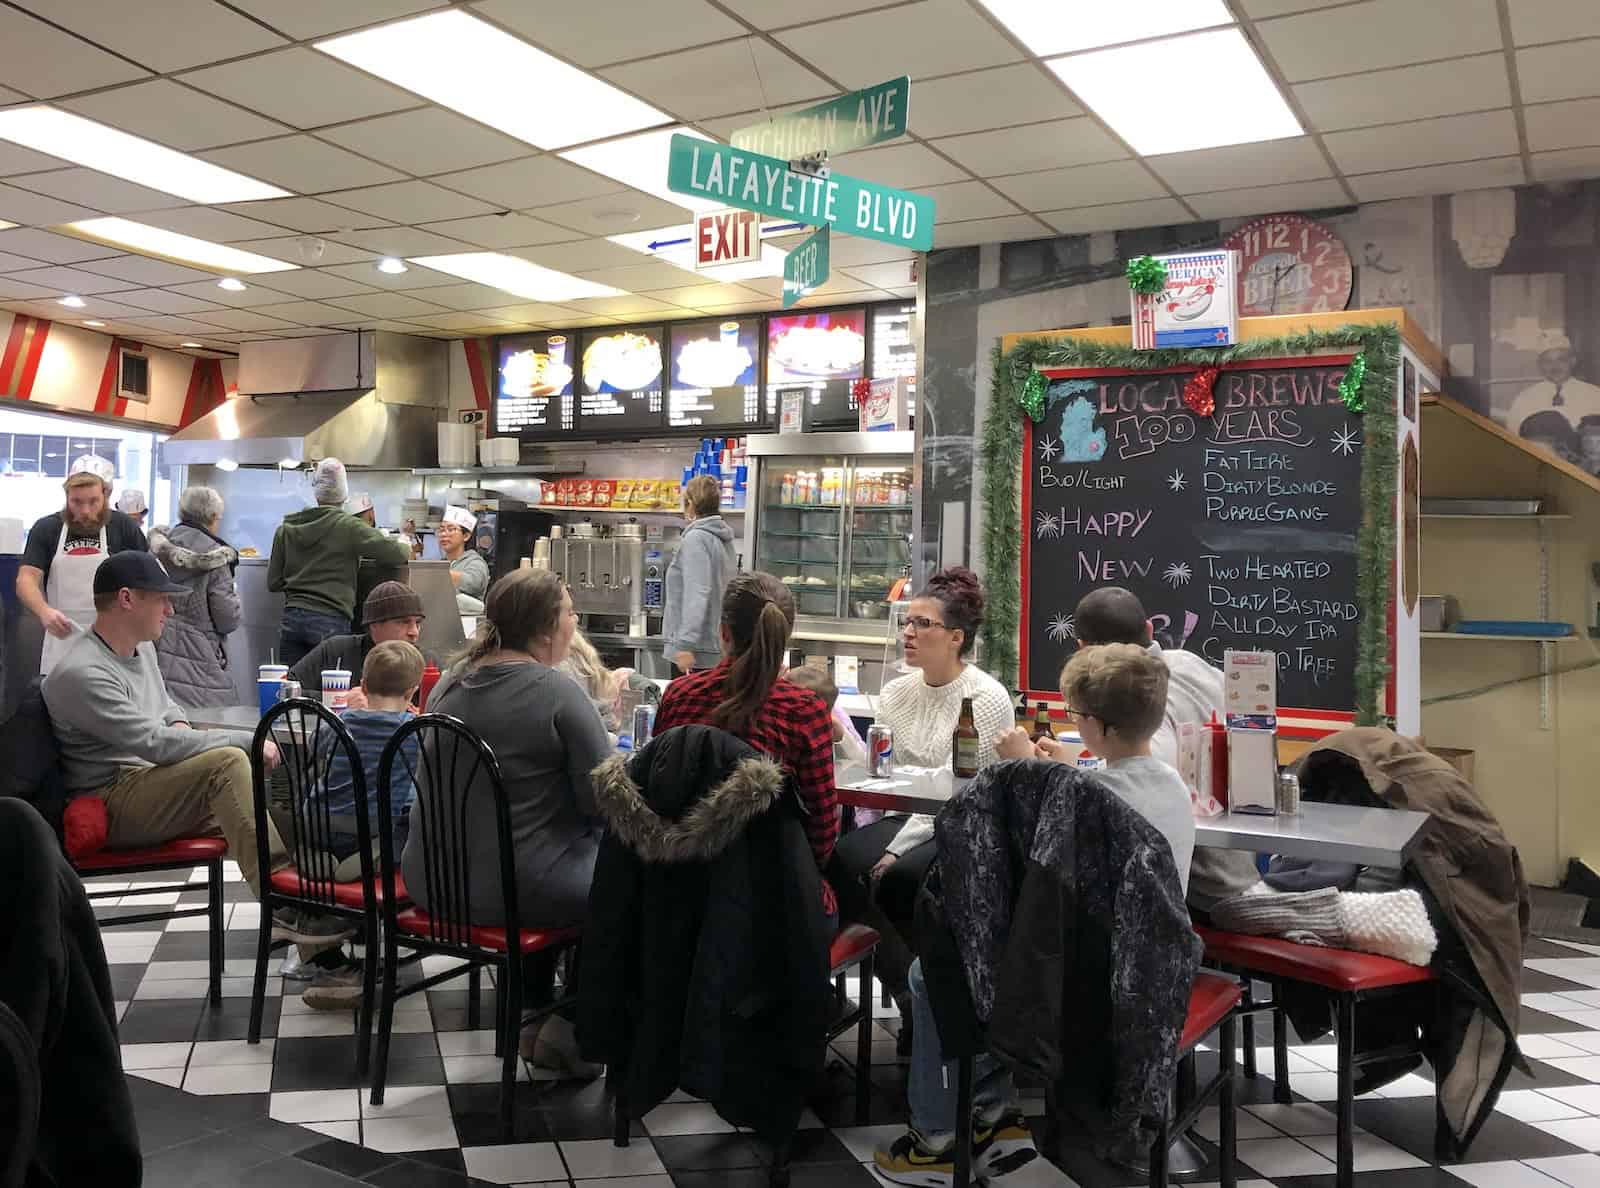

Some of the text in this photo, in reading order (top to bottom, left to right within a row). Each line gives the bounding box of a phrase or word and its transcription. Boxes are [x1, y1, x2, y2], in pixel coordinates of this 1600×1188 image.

[854, 87, 898, 138] AVE
[690, 146, 917, 240] LAFAYETTE BLVD
[699, 211, 756, 263] EXIT
[1243, 231, 1261, 256] 11
[1264, 223, 1290, 248] 12
[1300, 228, 1309, 253] 1
[793, 242, 817, 294] BEER
[1314, 240, 1332, 266] 2
[1155, 290, 1175, 304] KIT
[1099, 371, 1345, 414] LOCA BREWS
[1213, 409, 1301, 440] YEARS
[1203, 471, 1337, 496] DIRTY BLONDE
[1061, 506, 1153, 538] HAPPY
[1078, 550, 1154, 582] NEW
[1200, 555, 1330, 580] TWO HEARTED
[1208, 584, 1359, 620] DIRTY BASTARD
